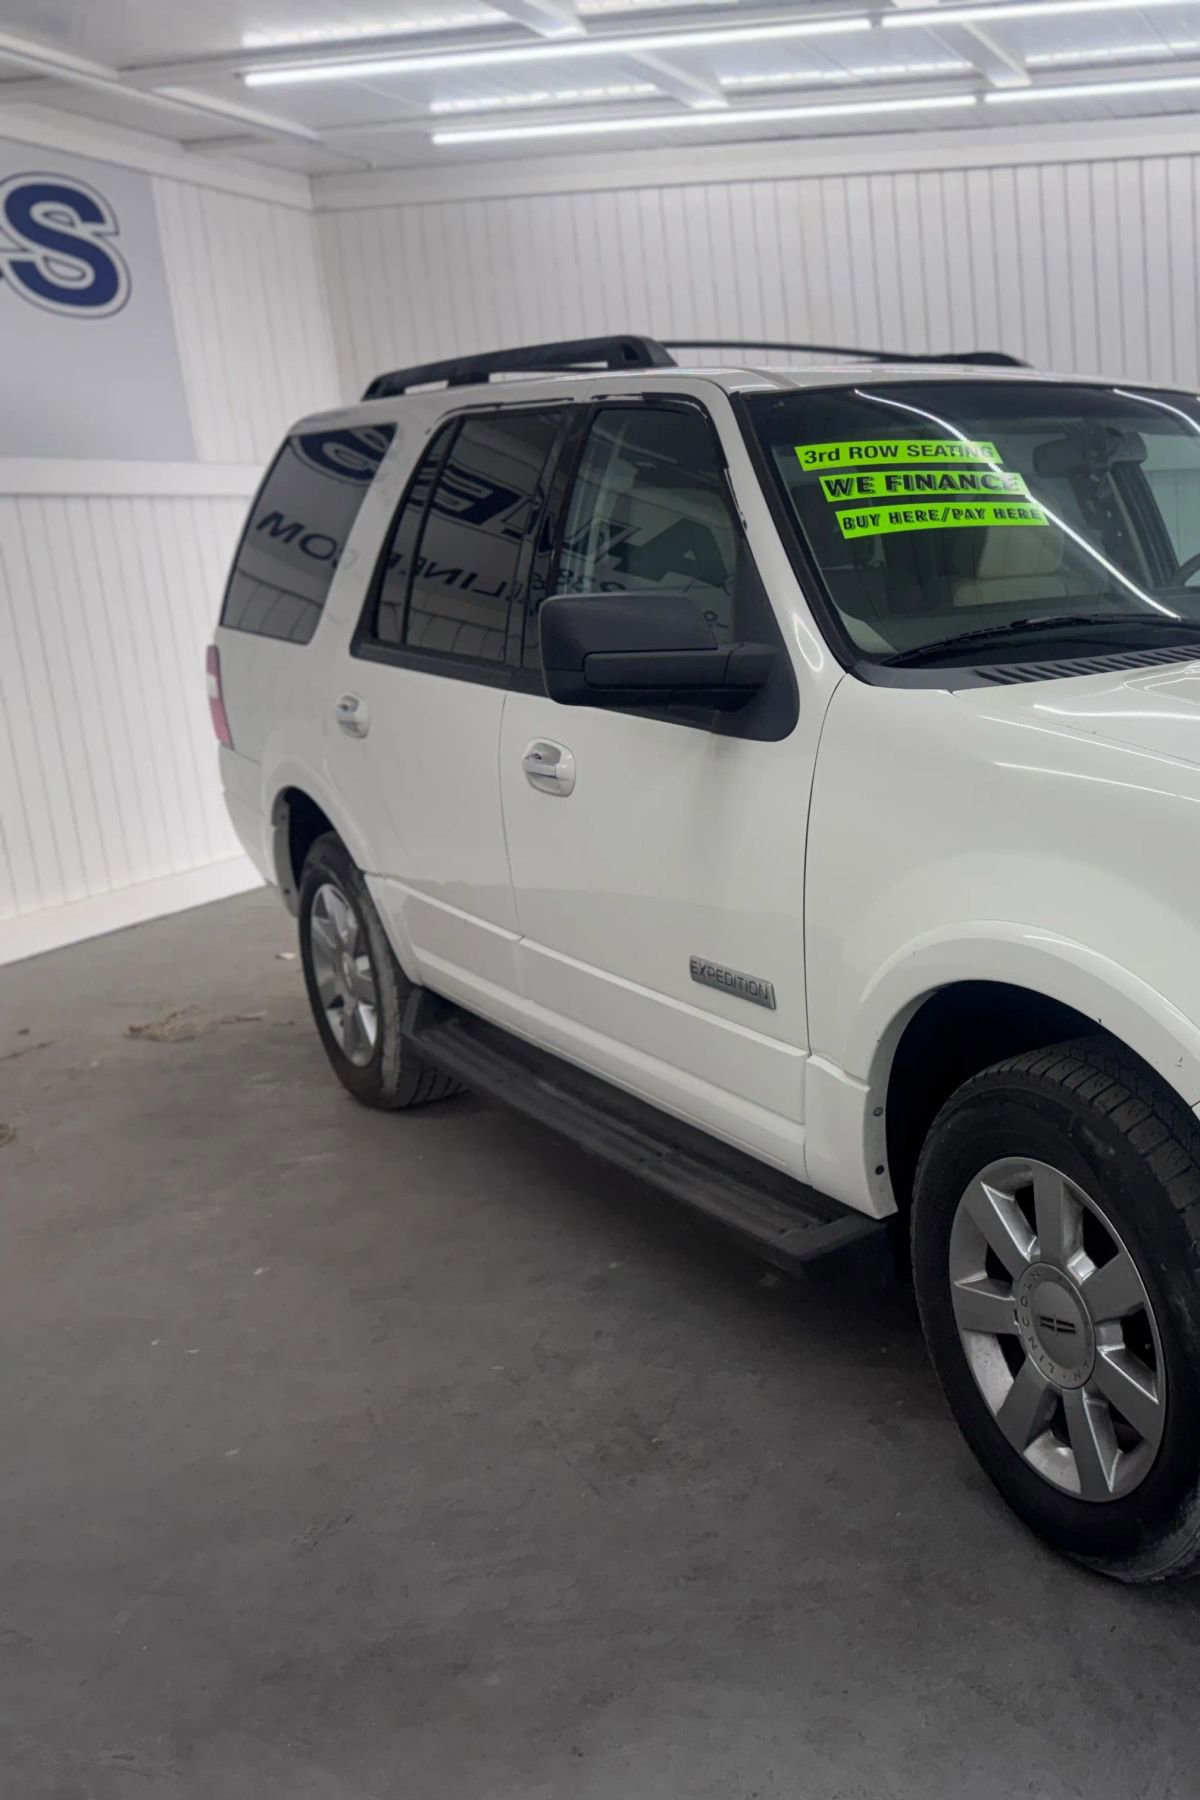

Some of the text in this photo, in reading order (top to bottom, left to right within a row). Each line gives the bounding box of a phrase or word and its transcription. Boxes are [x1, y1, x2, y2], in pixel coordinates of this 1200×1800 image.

[803, 443, 994, 465] 3rd ROW SEATING
[823, 473, 1020, 497] WE FINANCE
[842, 506, 1043, 531] BUY HERE/PAY HERE
[689, 959, 770, 1001] EXPEDITION
